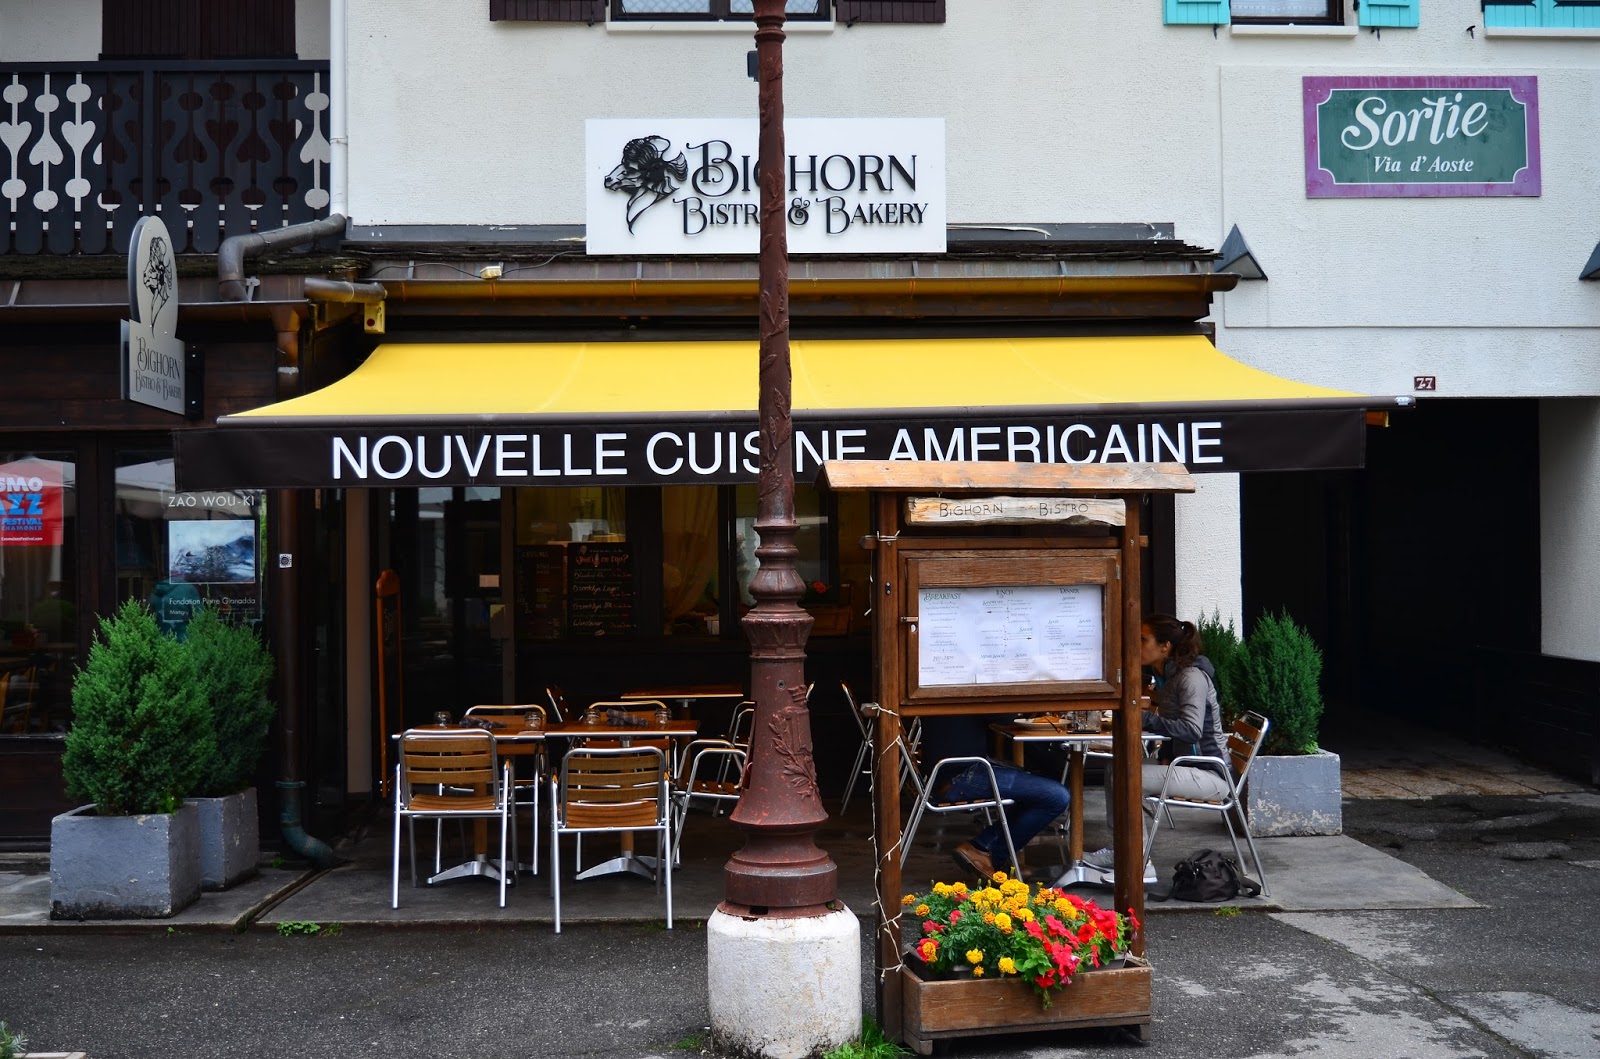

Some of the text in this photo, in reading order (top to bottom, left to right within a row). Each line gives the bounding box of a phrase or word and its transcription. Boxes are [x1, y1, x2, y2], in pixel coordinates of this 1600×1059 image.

[1341, 92, 1488, 150] Sortie
[686, 140, 917, 197] BIHORN
[1374, 156, 1401, 172] Via
[672, 196, 929, 236] BISTR & BAKERY
[136, 336, 181, 381] BIGHORN
[133, 369, 182, 401] BISTRO & BAKERY
[333, 421, 1223, 480] NOUVELLE CUISNE AMERICAINE
[168, 495, 255, 507] ZAO WOU-KI
[1, 517, 43, 525] FESTIVAL
[169, 597, 200, 605] Fondation
[222, 596, 256, 605] Gianadda
[923, 592, 962, 602] BREAKFAST
